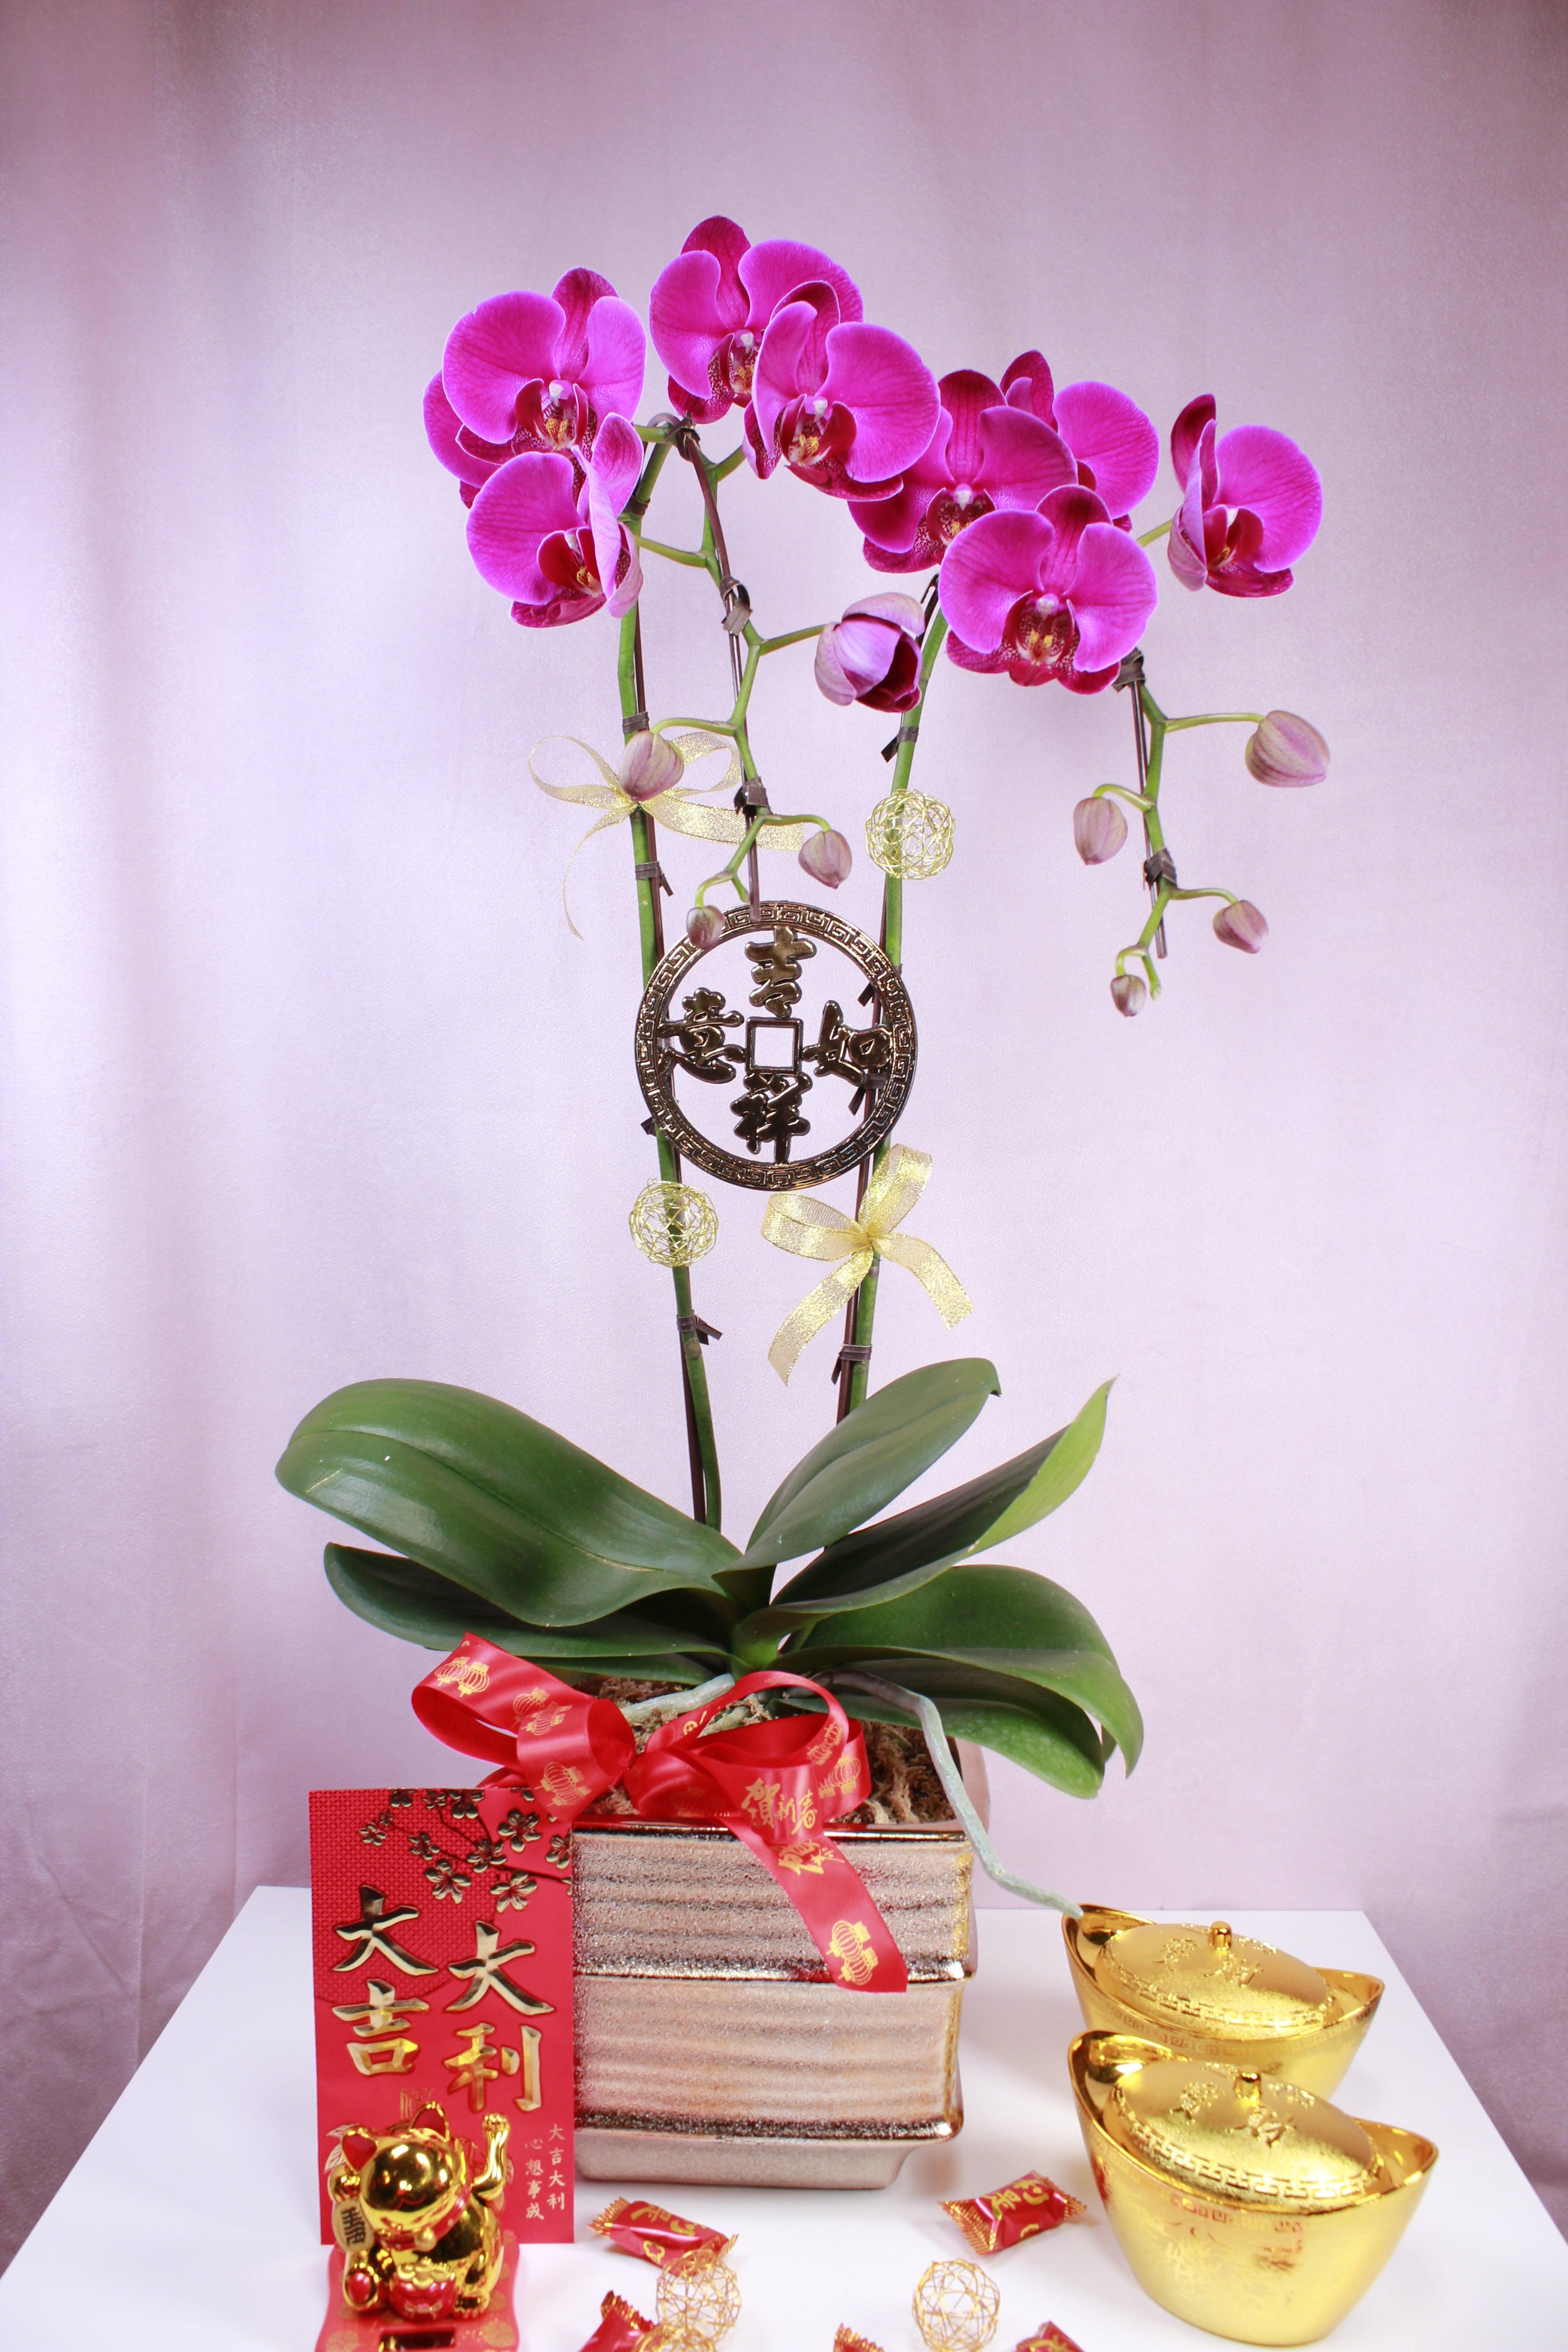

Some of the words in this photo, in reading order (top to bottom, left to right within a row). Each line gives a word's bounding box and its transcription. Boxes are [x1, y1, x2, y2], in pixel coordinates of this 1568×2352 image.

[332, 1884, 439, 2076] 大吉
[444, 1920, 555, 2112] 大利
[524, 2138, 544, 2220] 心想事成
[547, 2123, 566, 2210] 大吉大利
